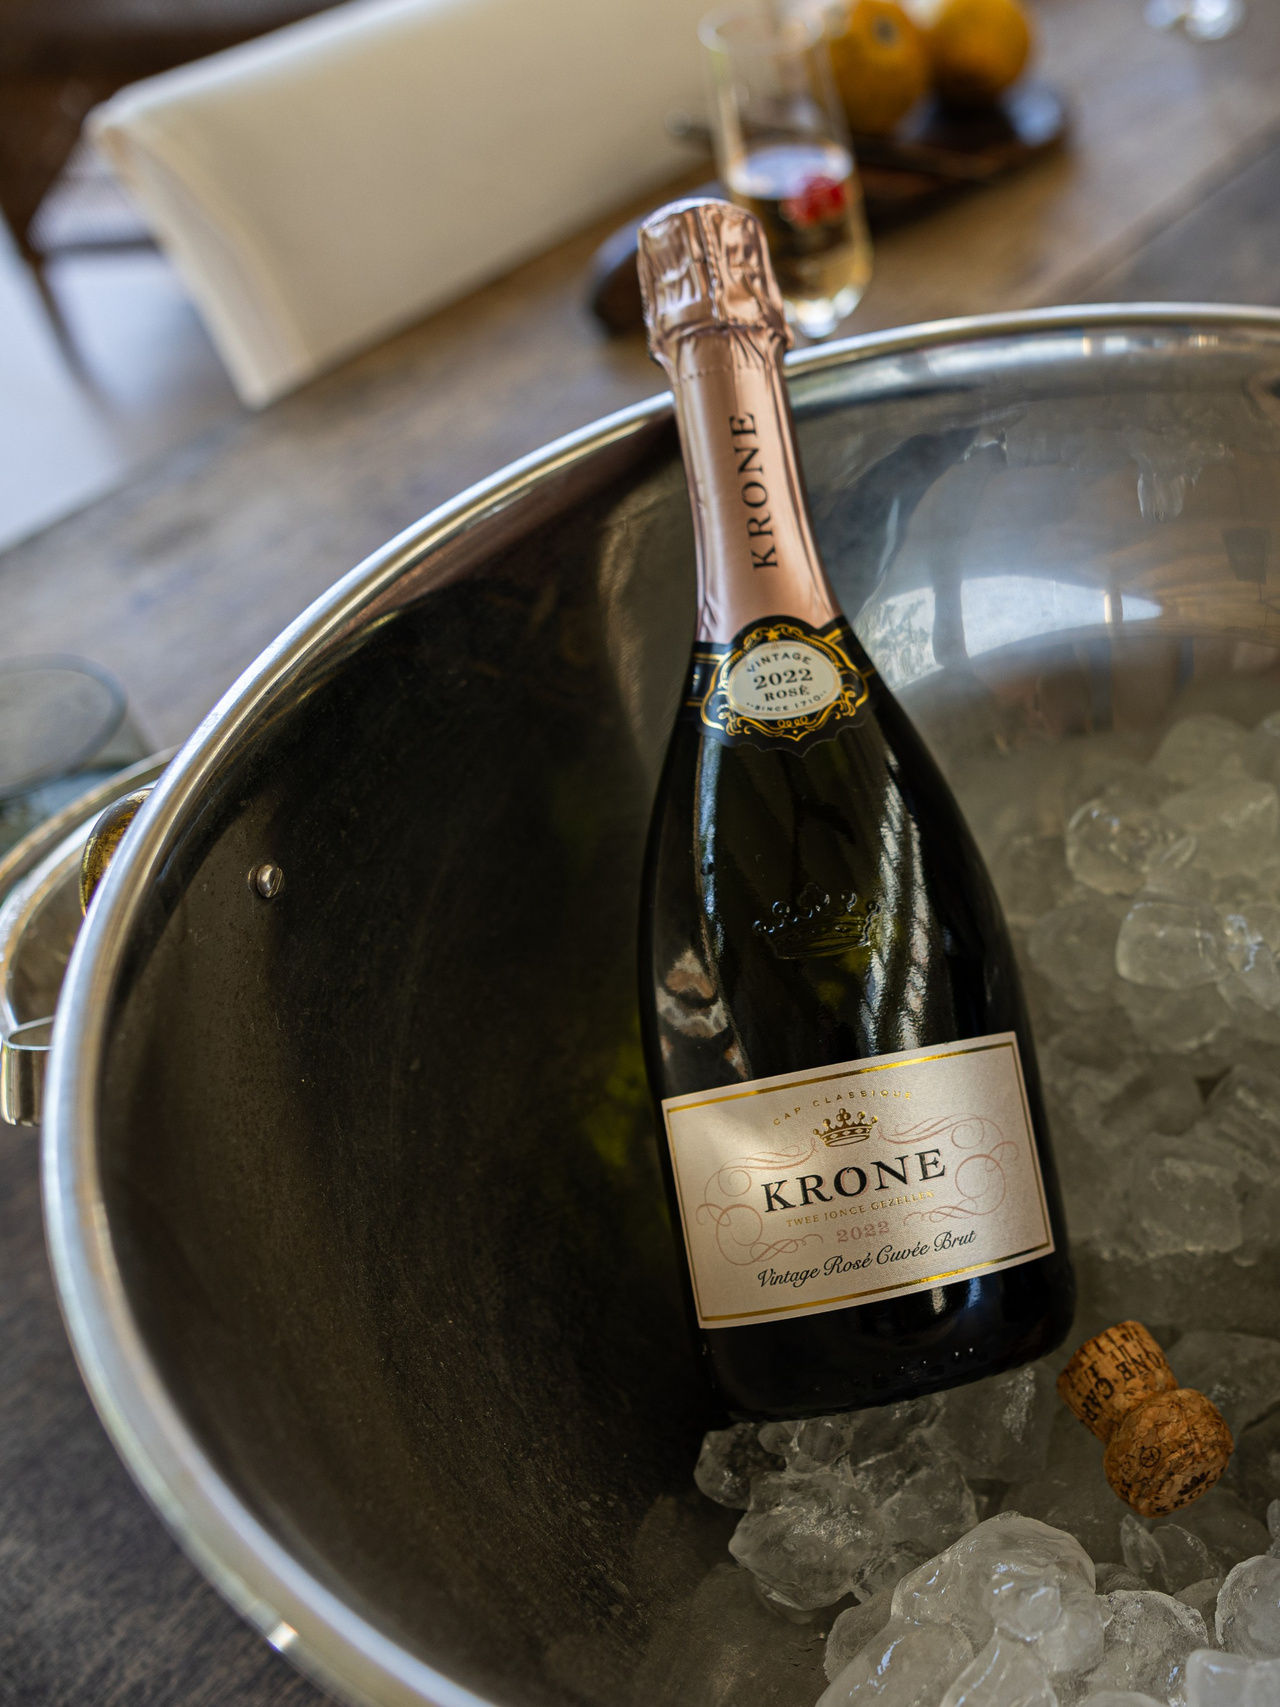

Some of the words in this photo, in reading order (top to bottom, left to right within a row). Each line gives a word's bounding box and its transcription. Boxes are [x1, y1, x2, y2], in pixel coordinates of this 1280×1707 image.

[729, 412, 778, 570] KRONE
[747, 652, 812, 673] VINTAGE
[753, 668, 813, 690] 2022
[764, 684, 810, 702] ROSÉ
[795, 695, 821, 709] 1710
[773, 1107, 801, 1126] CAP
[812, 1090, 912, 1107] CLASSIQUE
[760, 1148, 946, 1213] KRONE
[786, 1212, 820, 1228] TWEE
[824, 1205, 866, 1223] JONGE
[870, 1190, 935, 1211] GEZELLEN
[836, 1220, 890, 1244] 2022
[757, 1267, 821, 1289] Vintage
[823, 1252, 874, 1277] Rosé
[876, 1242, 930, 1266] Cuvée
[933, 1229, 977, 1252] Brut
